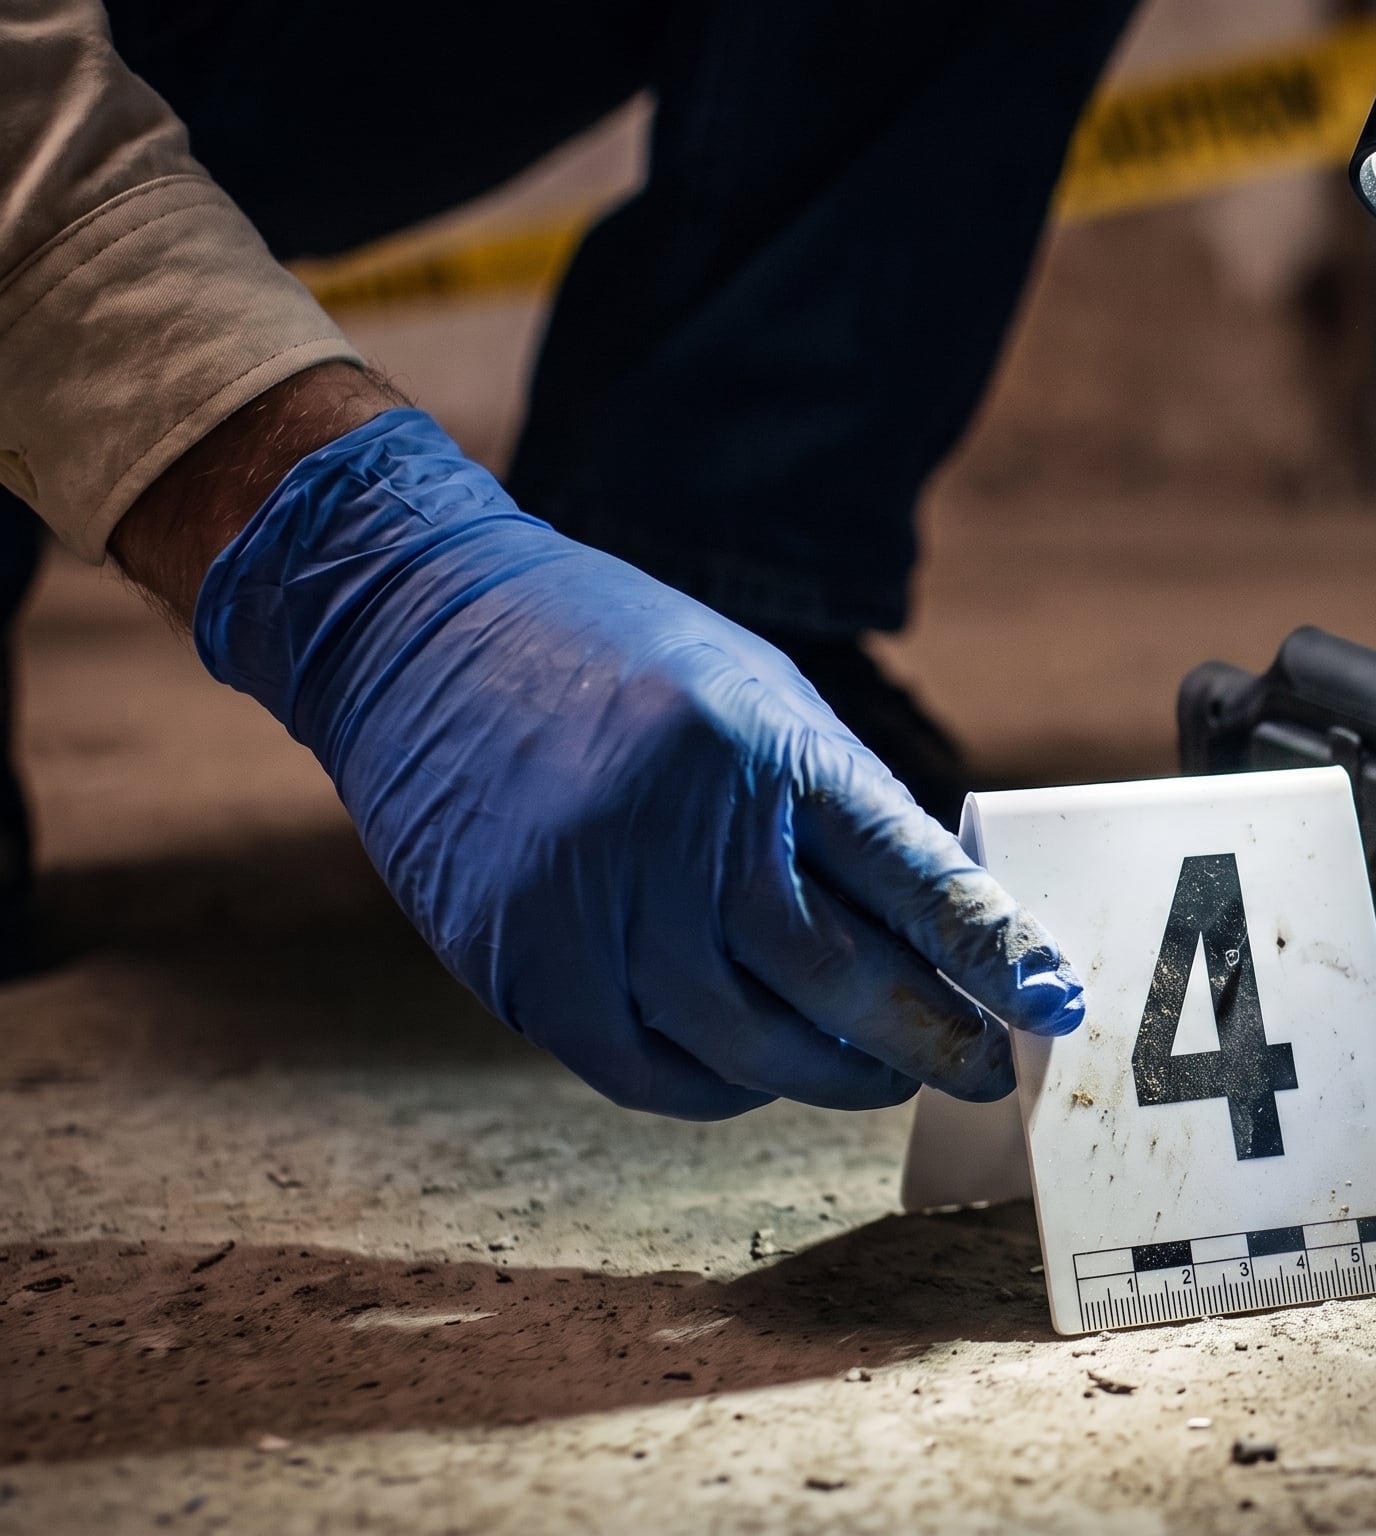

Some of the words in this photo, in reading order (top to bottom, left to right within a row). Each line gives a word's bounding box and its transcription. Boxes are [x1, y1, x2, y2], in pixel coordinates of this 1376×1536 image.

[1131, 853, 1299, 1161] 4
[1127, 1278, 1135, 1294] 1
[1181, 1269, 1193, 1286] 2
[1239, 1262, 1250, 1278] 3
[1296, 1253, 1307, 1271] 4
[1351, 1247, 1361, 1263] 5
